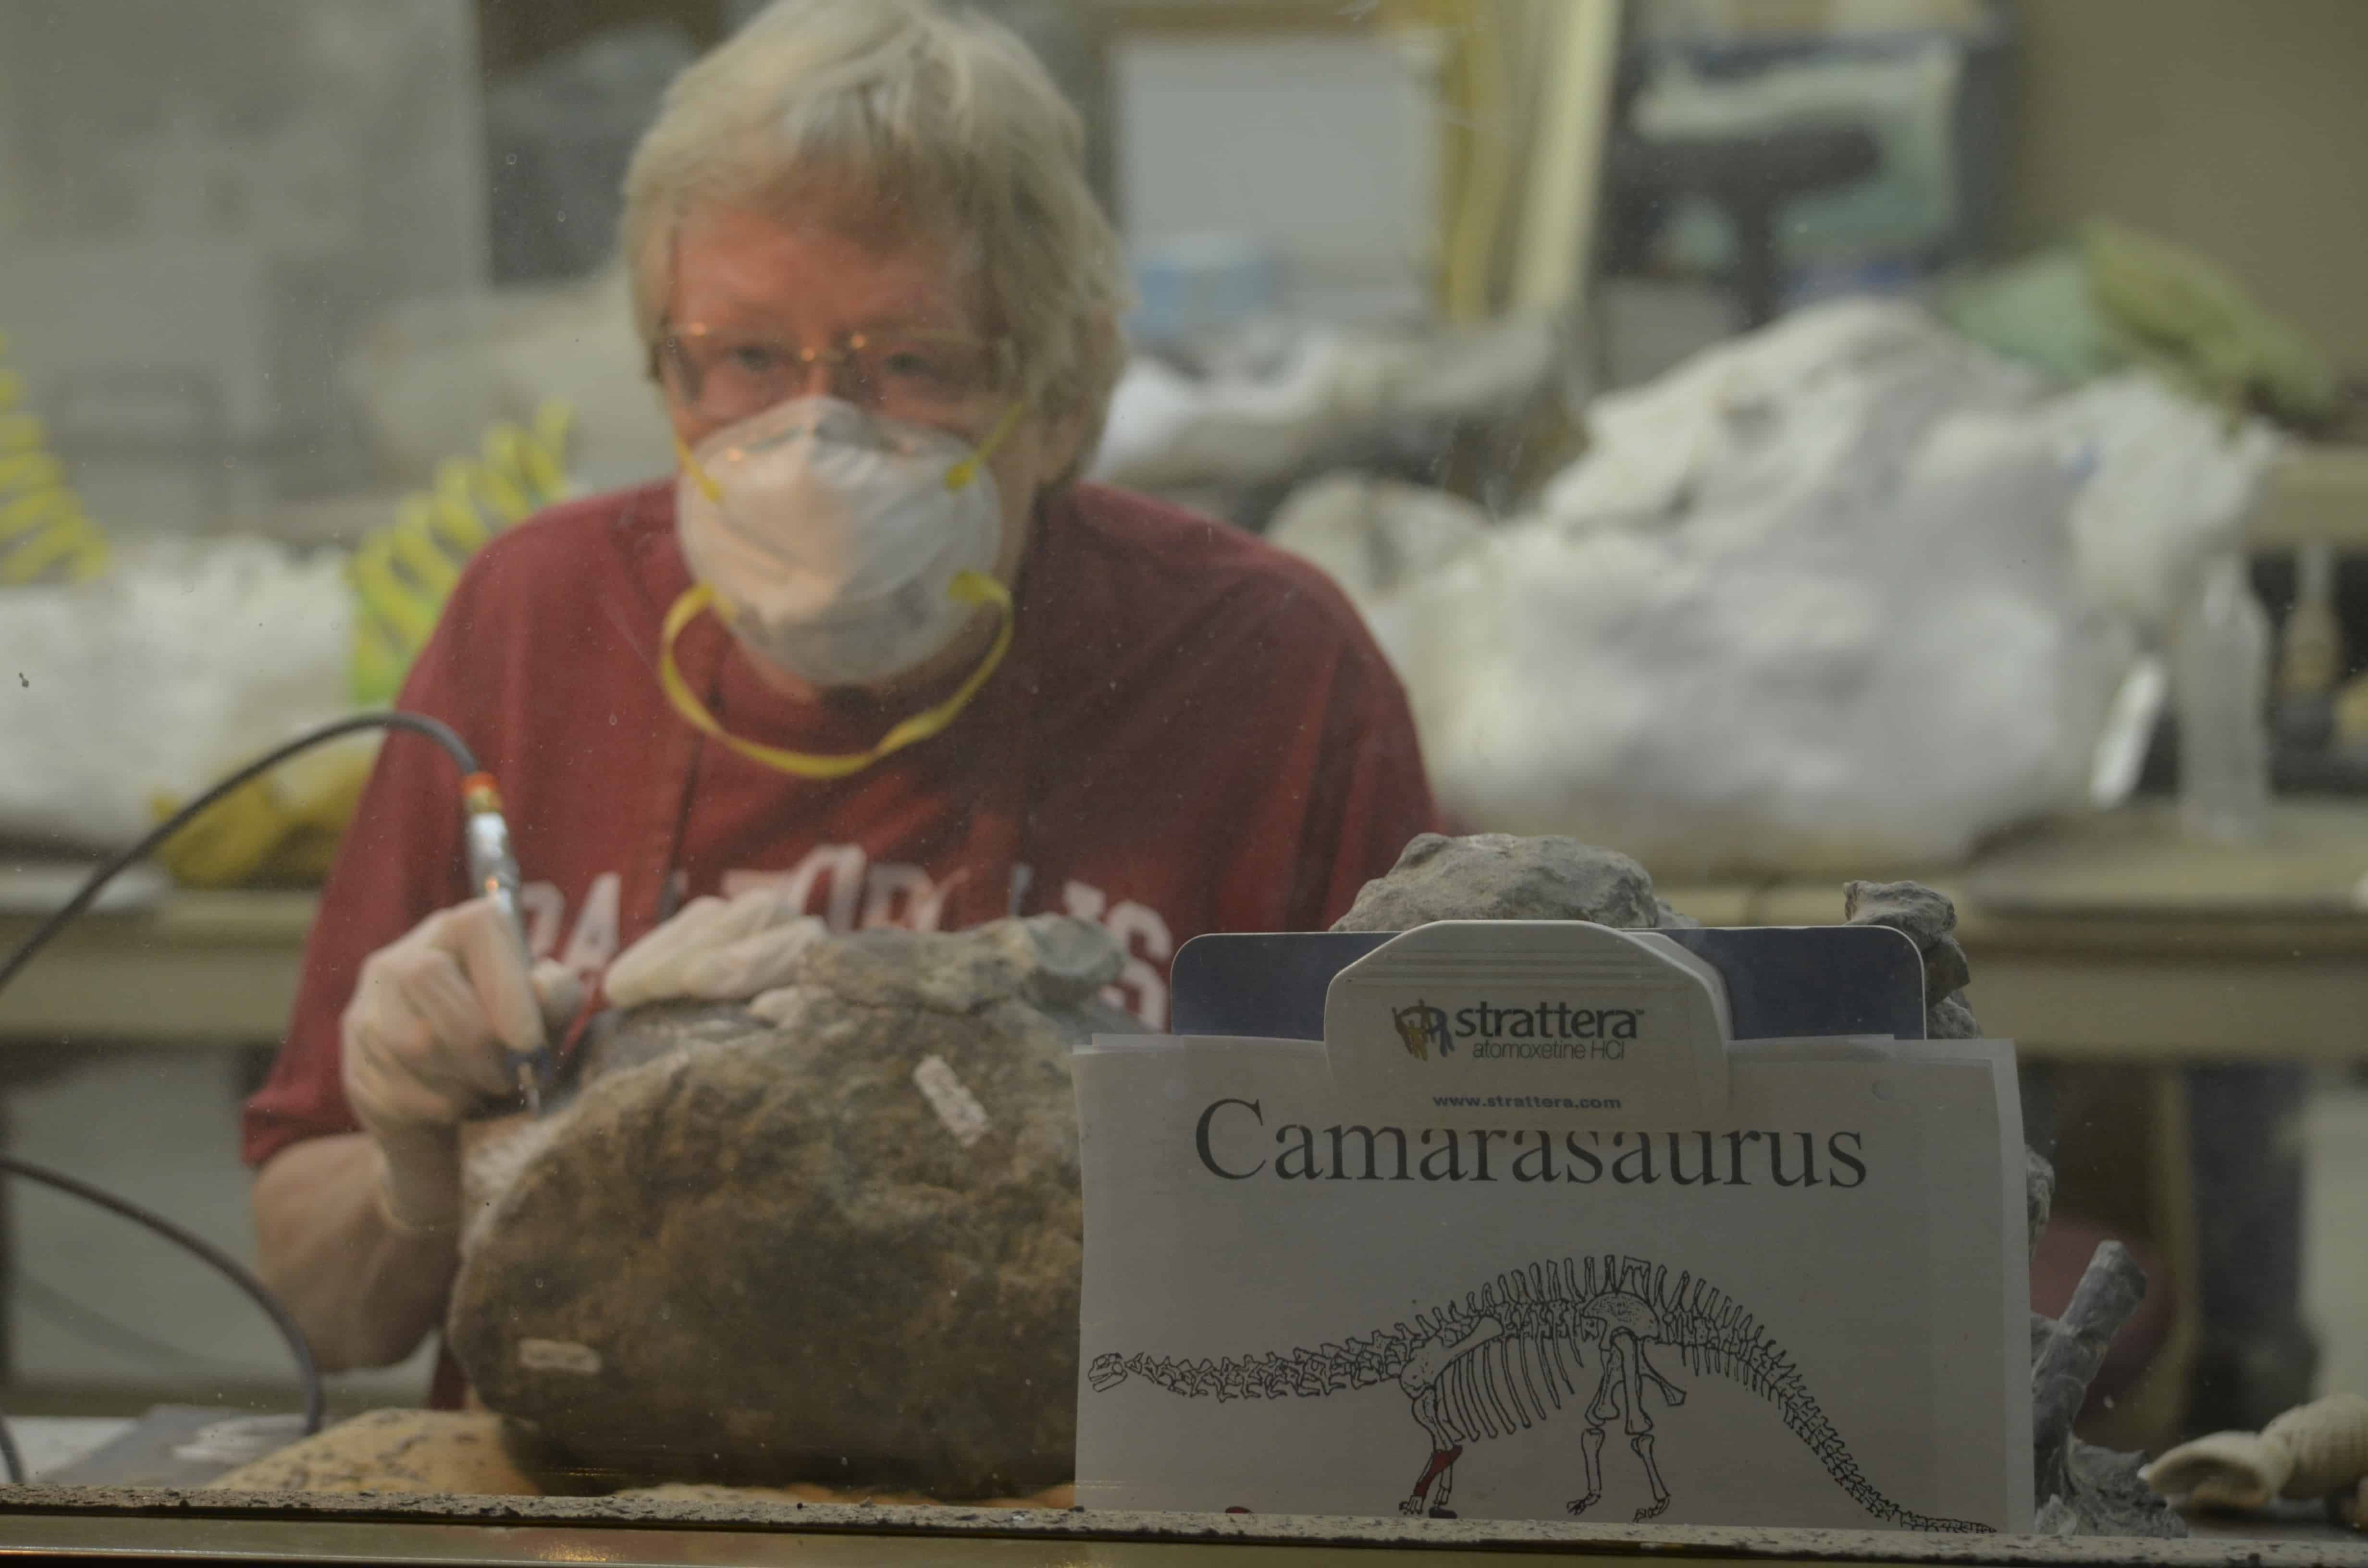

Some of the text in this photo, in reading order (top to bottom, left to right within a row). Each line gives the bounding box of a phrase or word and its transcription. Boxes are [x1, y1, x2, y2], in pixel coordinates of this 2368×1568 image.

[1472, 1041, 1585, 1060] atomoxetine
[1432, 1096, 1622, 1109] www.strattera.com
[1195, 1096, 1868, 1188] Camarasaurus
